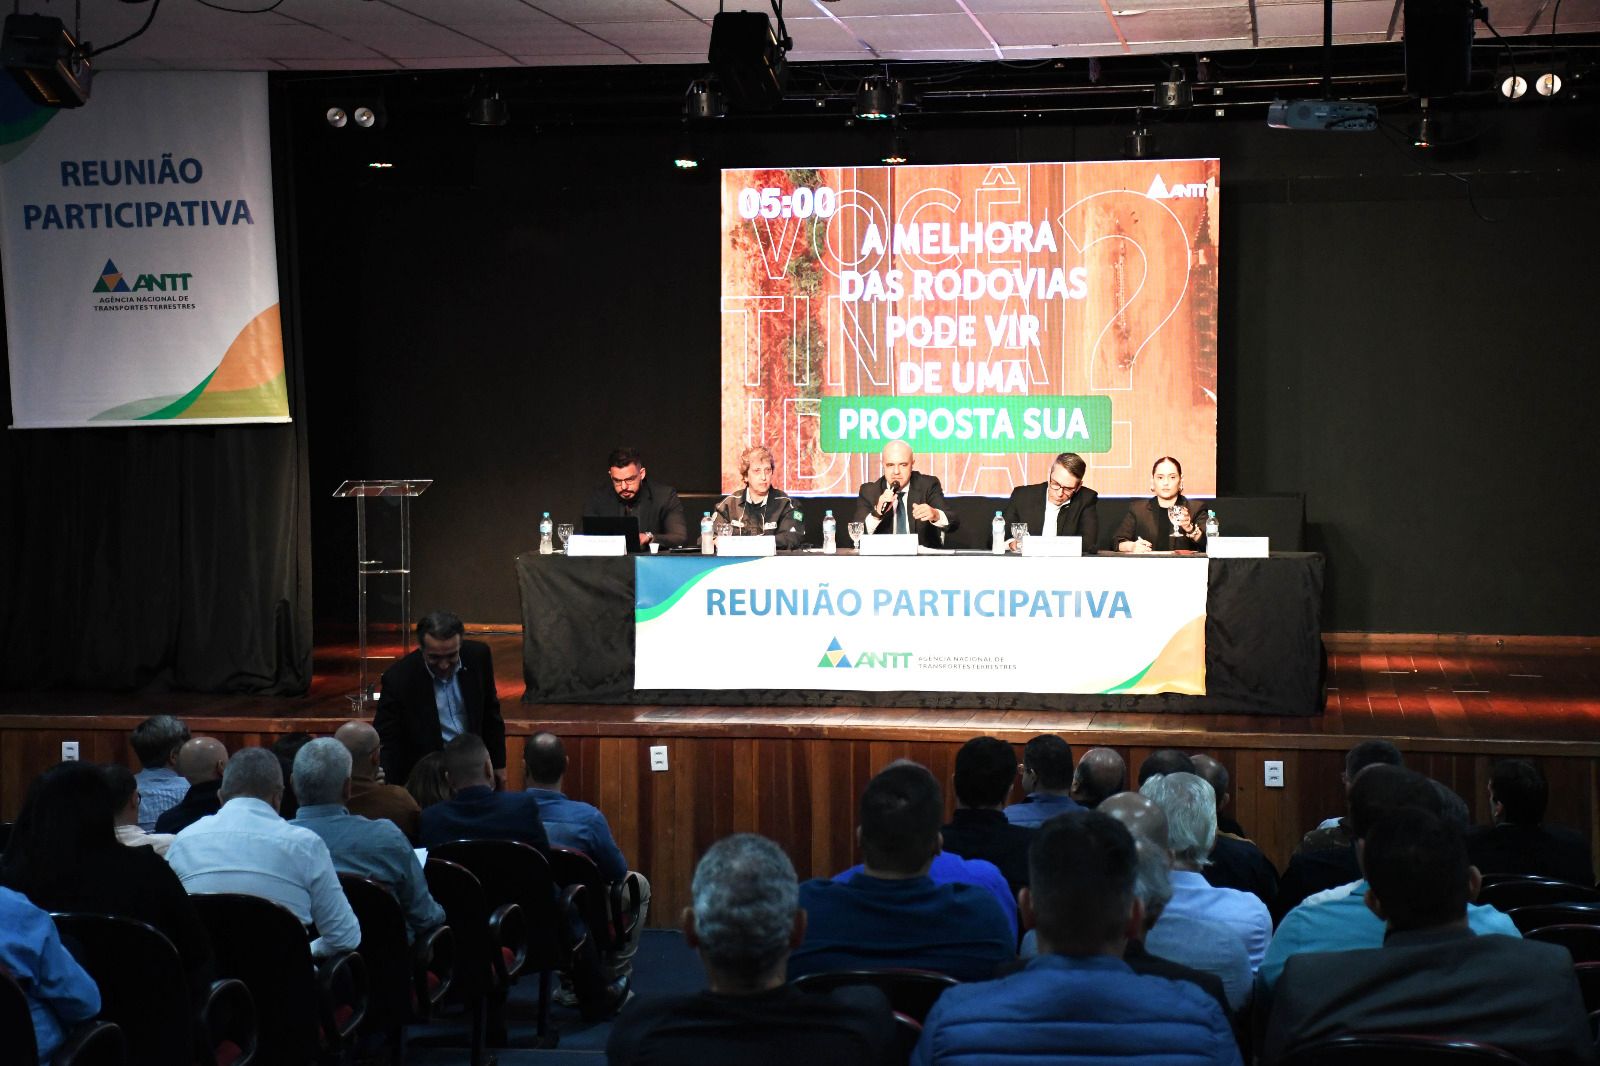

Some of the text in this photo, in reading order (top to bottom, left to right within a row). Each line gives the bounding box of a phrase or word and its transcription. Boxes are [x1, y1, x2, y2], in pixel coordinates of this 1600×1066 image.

[60, 153, 203, 187] REUNIÃO
[738, 186, 836, 220] 05:00
[1168, 183, 1207, 198] ANTT
[23, 199, 255, 230] PARTICIPATIVA
[860, 220, 1058, 256] A MELHORA
[131, 272, 193, 292] ANTT
[838, 267, 1089, 303] DAS RODOVIAS
[136, 295, 177, 303] NACIONAL
[150, 303, 196, 311] TERRESTRES
[885, 315, 1041, 348] PODE VIR
[899, 360, 1027, 394] DE UMA
[838, 406, 1090, 441] PROPOSTA SUA
[706, 583, 1132, 618] REUNIÃO PARTICIPATIVA
[853, 651, 913, 669] ANTT
